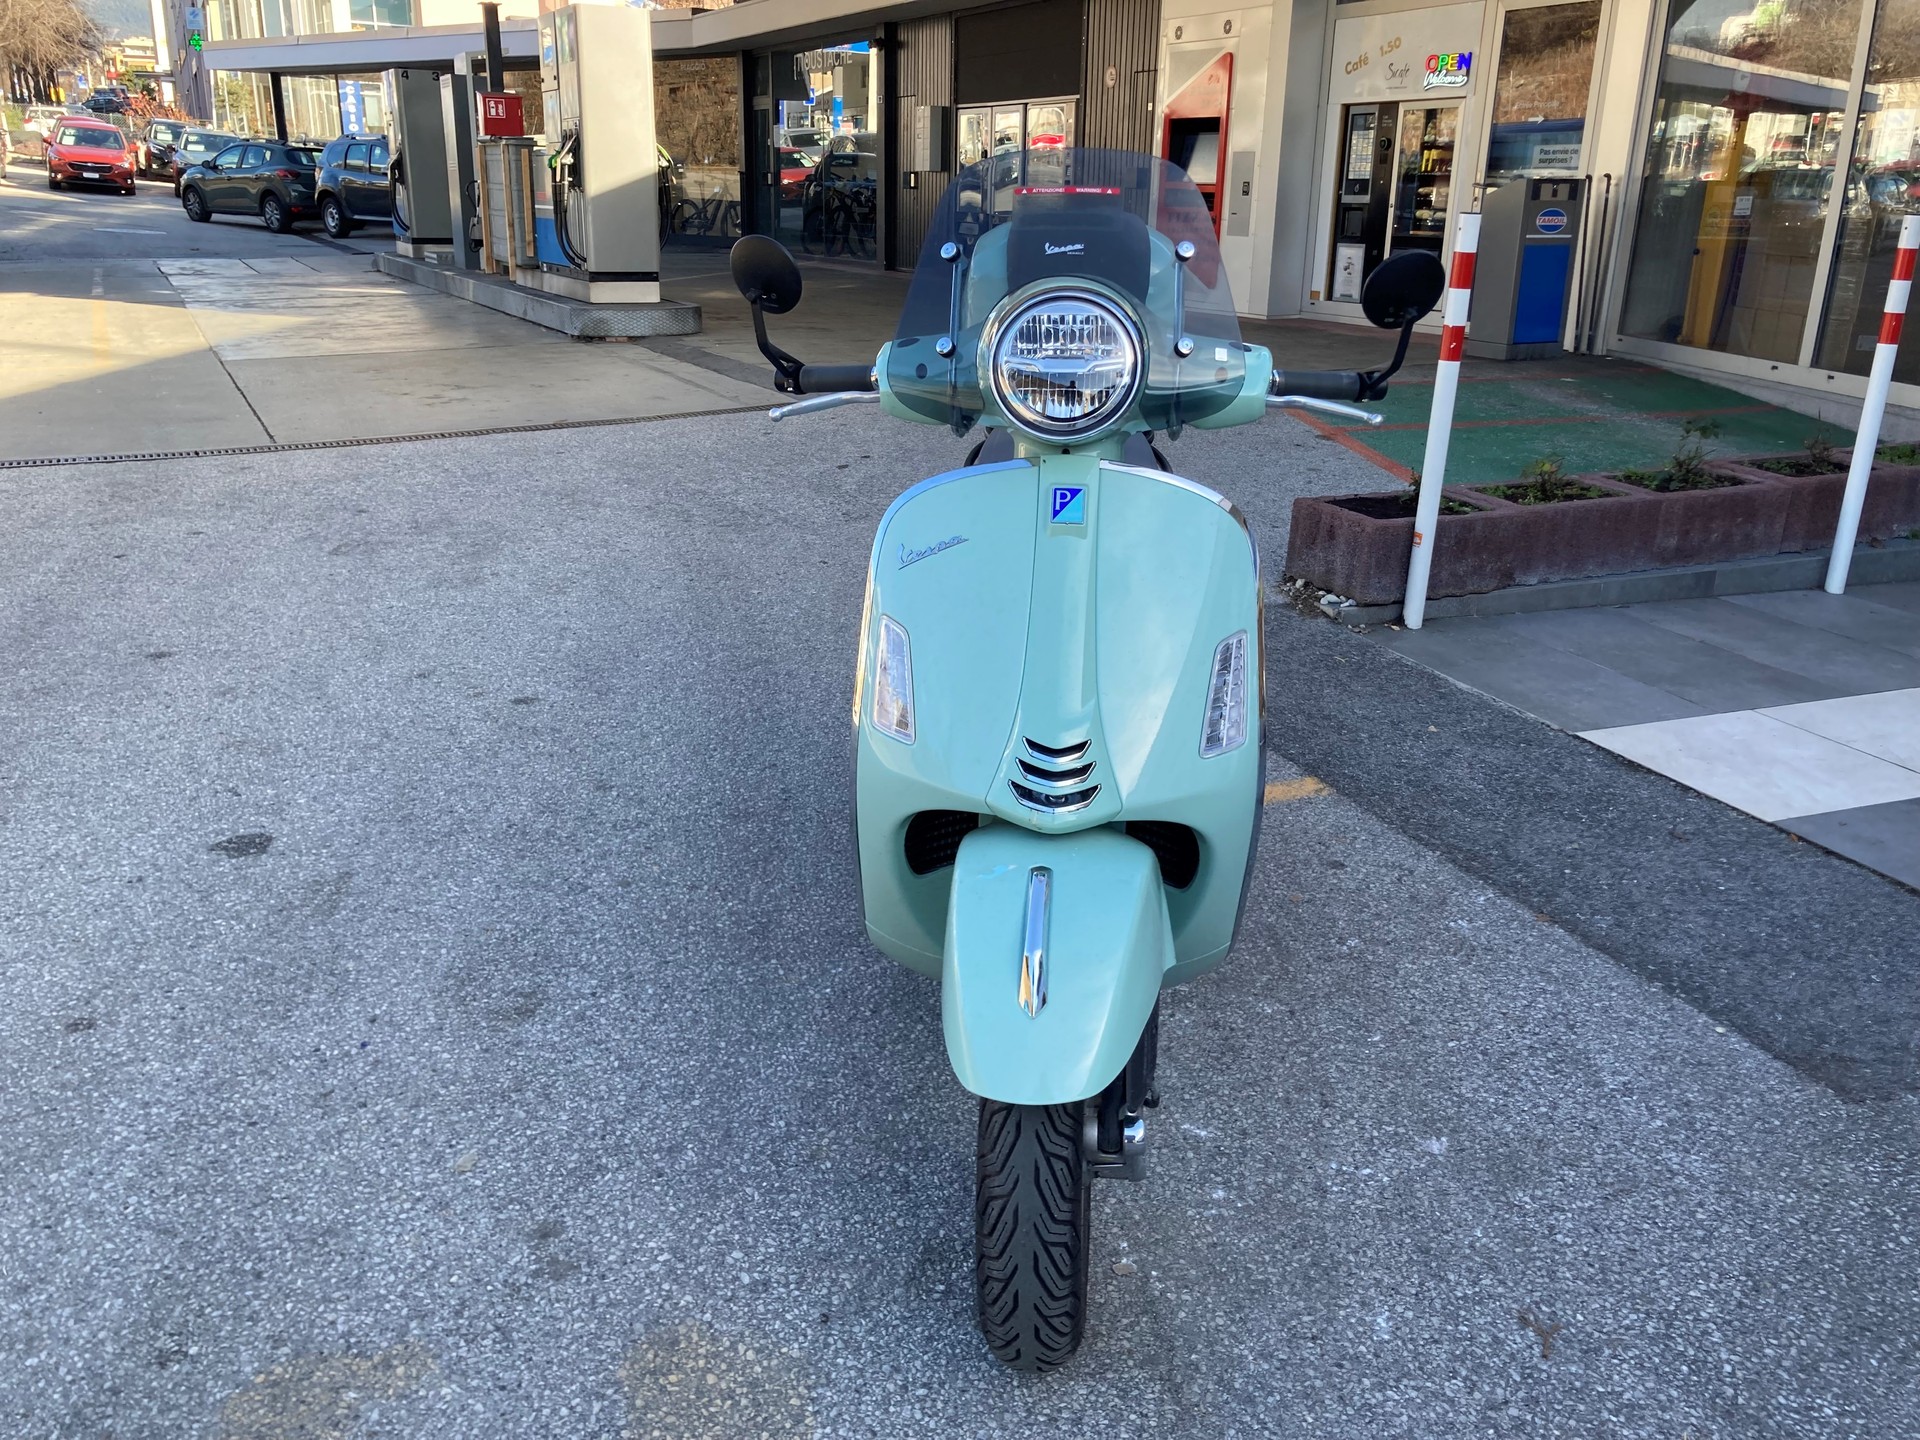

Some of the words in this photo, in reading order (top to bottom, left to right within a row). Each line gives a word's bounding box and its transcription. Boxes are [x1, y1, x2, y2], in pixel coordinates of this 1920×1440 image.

[1344, 52, 1369, 75] Café
[1379, 36, 1402, 57] 1.50
[1425, 52, 1472, 73] OPEN
[401, 70, 409, 80] 4
[432, 71, 440, 81] 3
[1423, 70, 1468, 91] Welcome
[1539, 148, 1551, 156] Pas
[1569, 147, 1579, 155] de
[1538, 157, 1568, 165] surprises
[1537, 216, 1567, 225] TAMOIL
[1045, 242, 1084, 255] Vespa
[1055, 490, 1071, 510] P
[899, 535, 969, 570] Vespa
